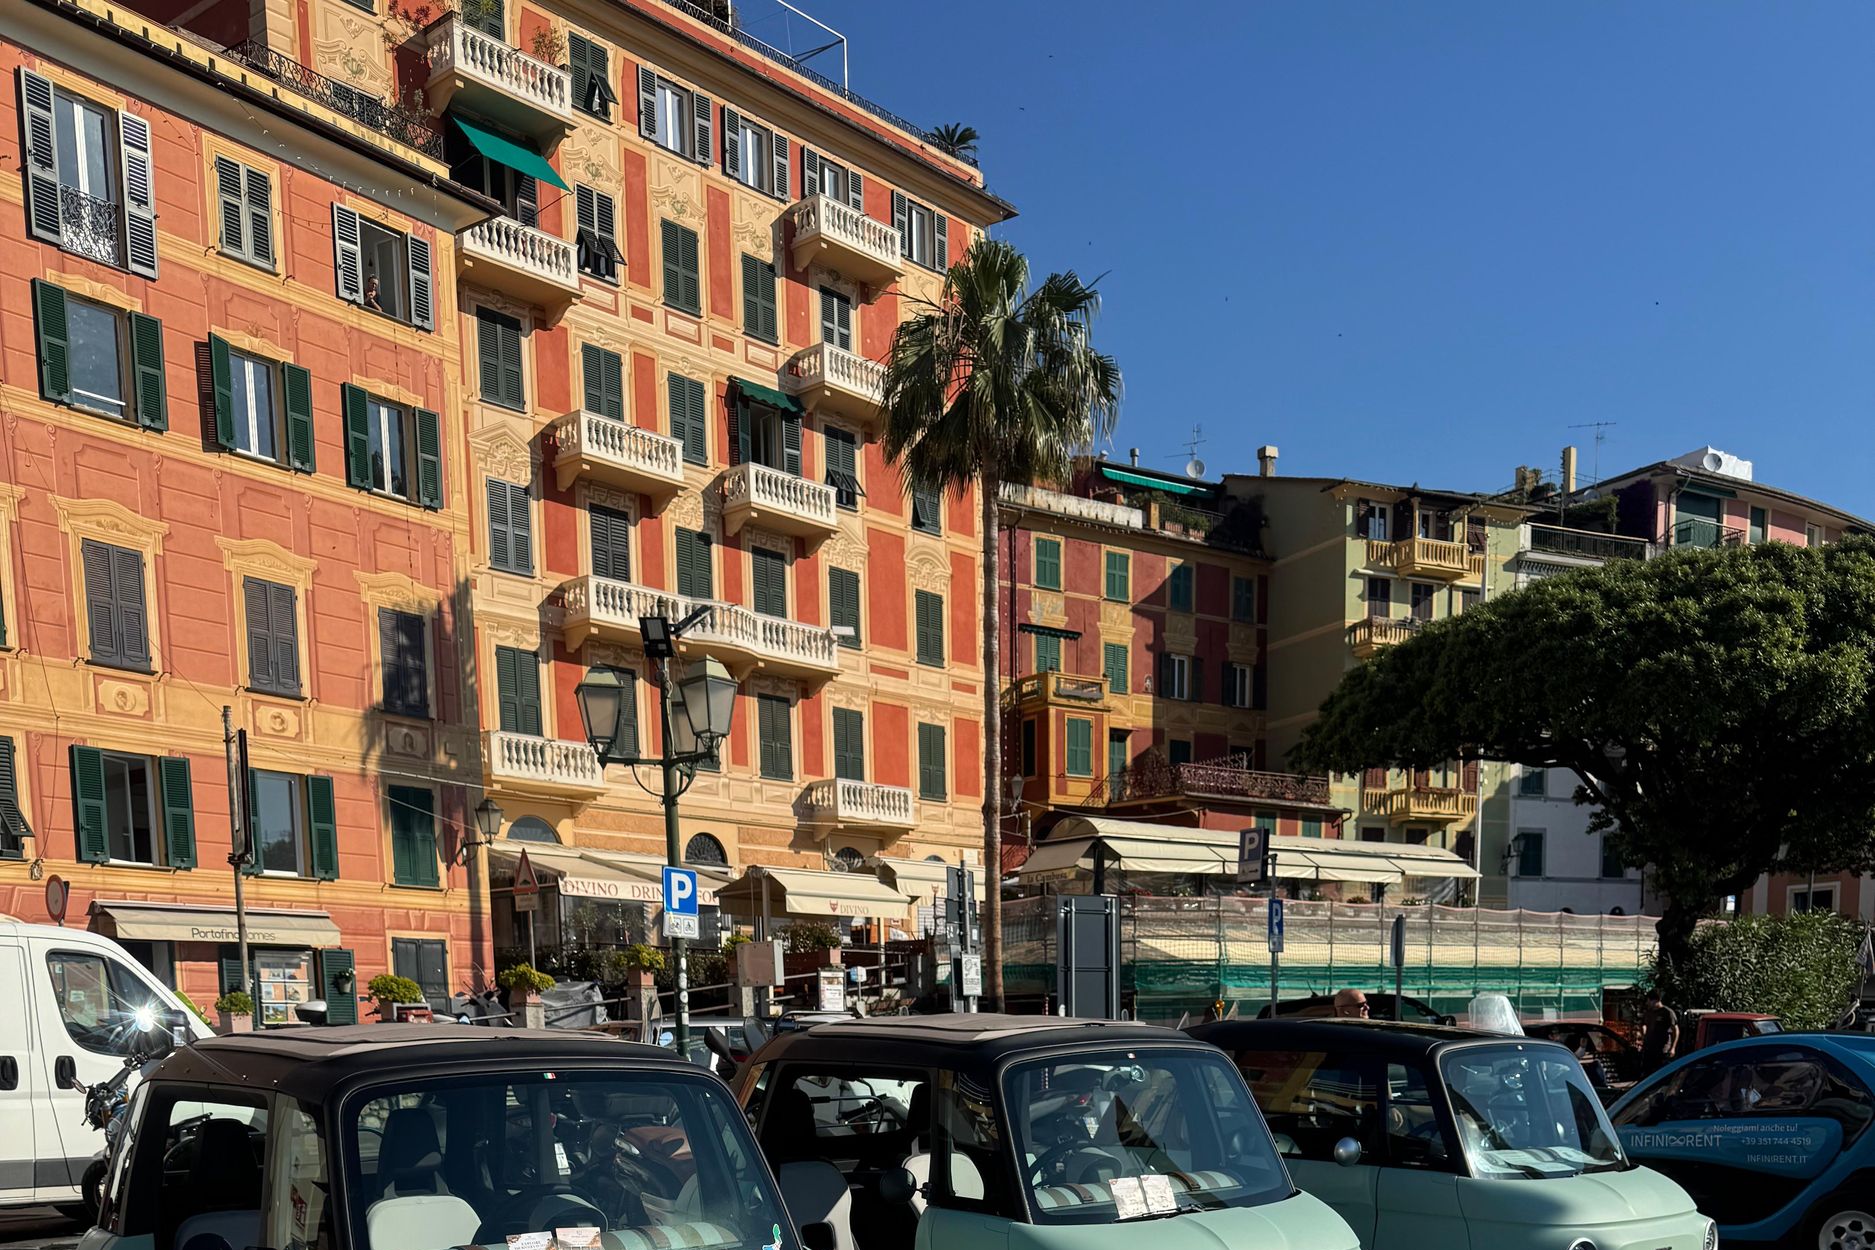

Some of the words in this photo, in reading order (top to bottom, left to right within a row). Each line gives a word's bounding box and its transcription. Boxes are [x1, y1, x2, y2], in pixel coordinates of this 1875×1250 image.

[1244, 832, 1259, 859] P
[564, 880, 619, 897] DIVINO
[670, 872, 693, 909] P
[840, 904, 869, 915] DIVINO
[1713, 1124, 1759, 1133] Noleggiami
[1760, 1124, 1785, 1132] anche
[1741, 1137, 1756, 1145] +39
